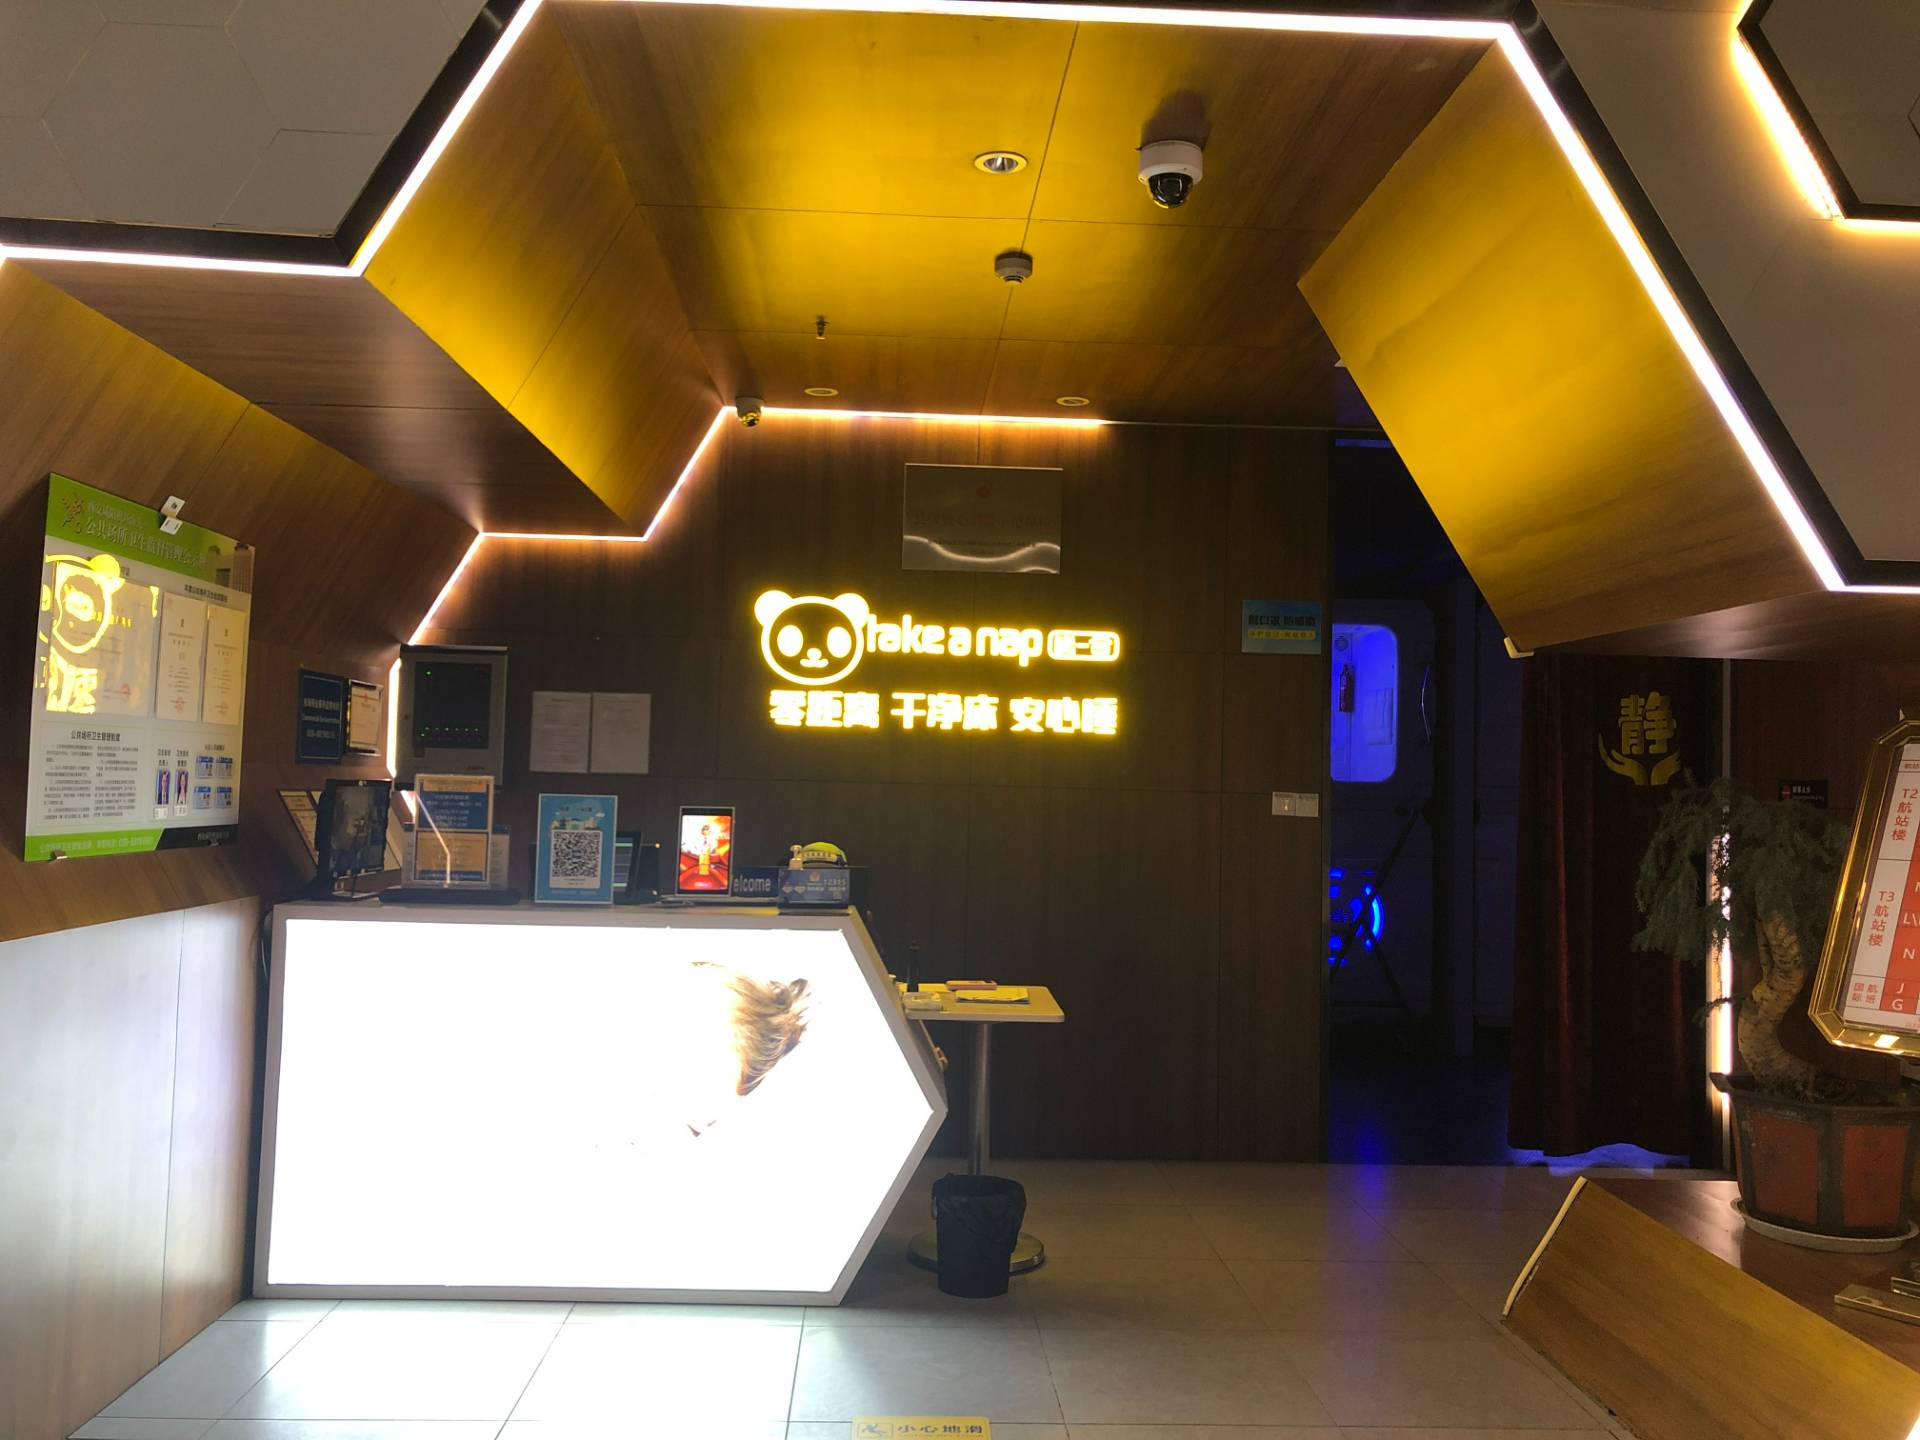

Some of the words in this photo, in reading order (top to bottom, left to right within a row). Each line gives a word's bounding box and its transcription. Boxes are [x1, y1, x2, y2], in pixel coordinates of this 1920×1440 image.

[867, 613, 945, 655] take
[948, 626, 972, 657] a
[976, 626, 1043, 668] nap
[769, 689, 880, 728] 零距离
[889, 691, 1000, 730] 干净床
[1009, 696, 1118, 735] 安心睡
[1617, 691, 1677, 755] 静
[732, 875, 772, 892] elcome
[1902, 948, 1916, 960] N
[1896, 982, 1905, 994] J
[1891, 999, 1904, 1010] G
